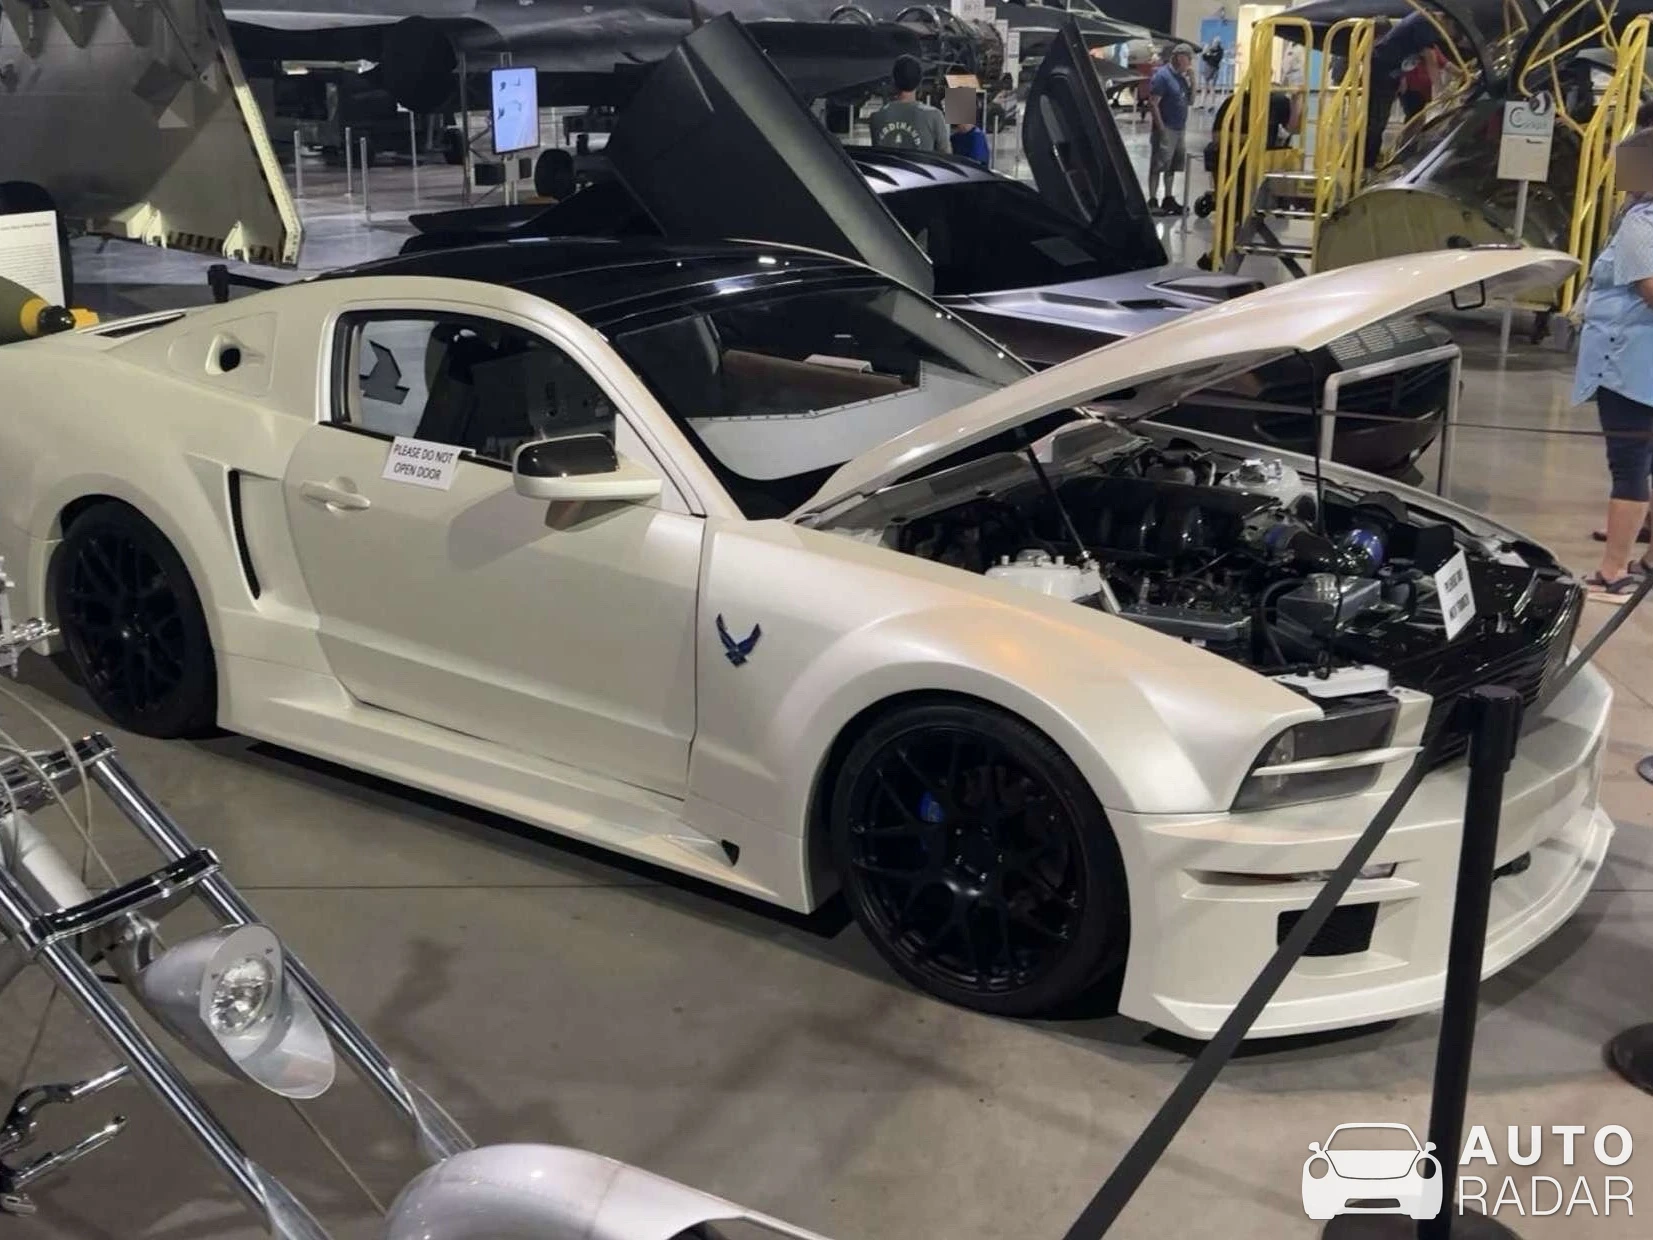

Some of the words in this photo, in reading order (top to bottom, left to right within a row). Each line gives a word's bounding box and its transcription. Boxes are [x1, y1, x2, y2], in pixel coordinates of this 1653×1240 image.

[394, 444, 421, 459] PLEASE
[422, 448, 434, 461] DO
[435, 451, 454, 464] NOT
[394, 462, 417, 476] OPEN
[416, 466, 442, 480] DOOR
